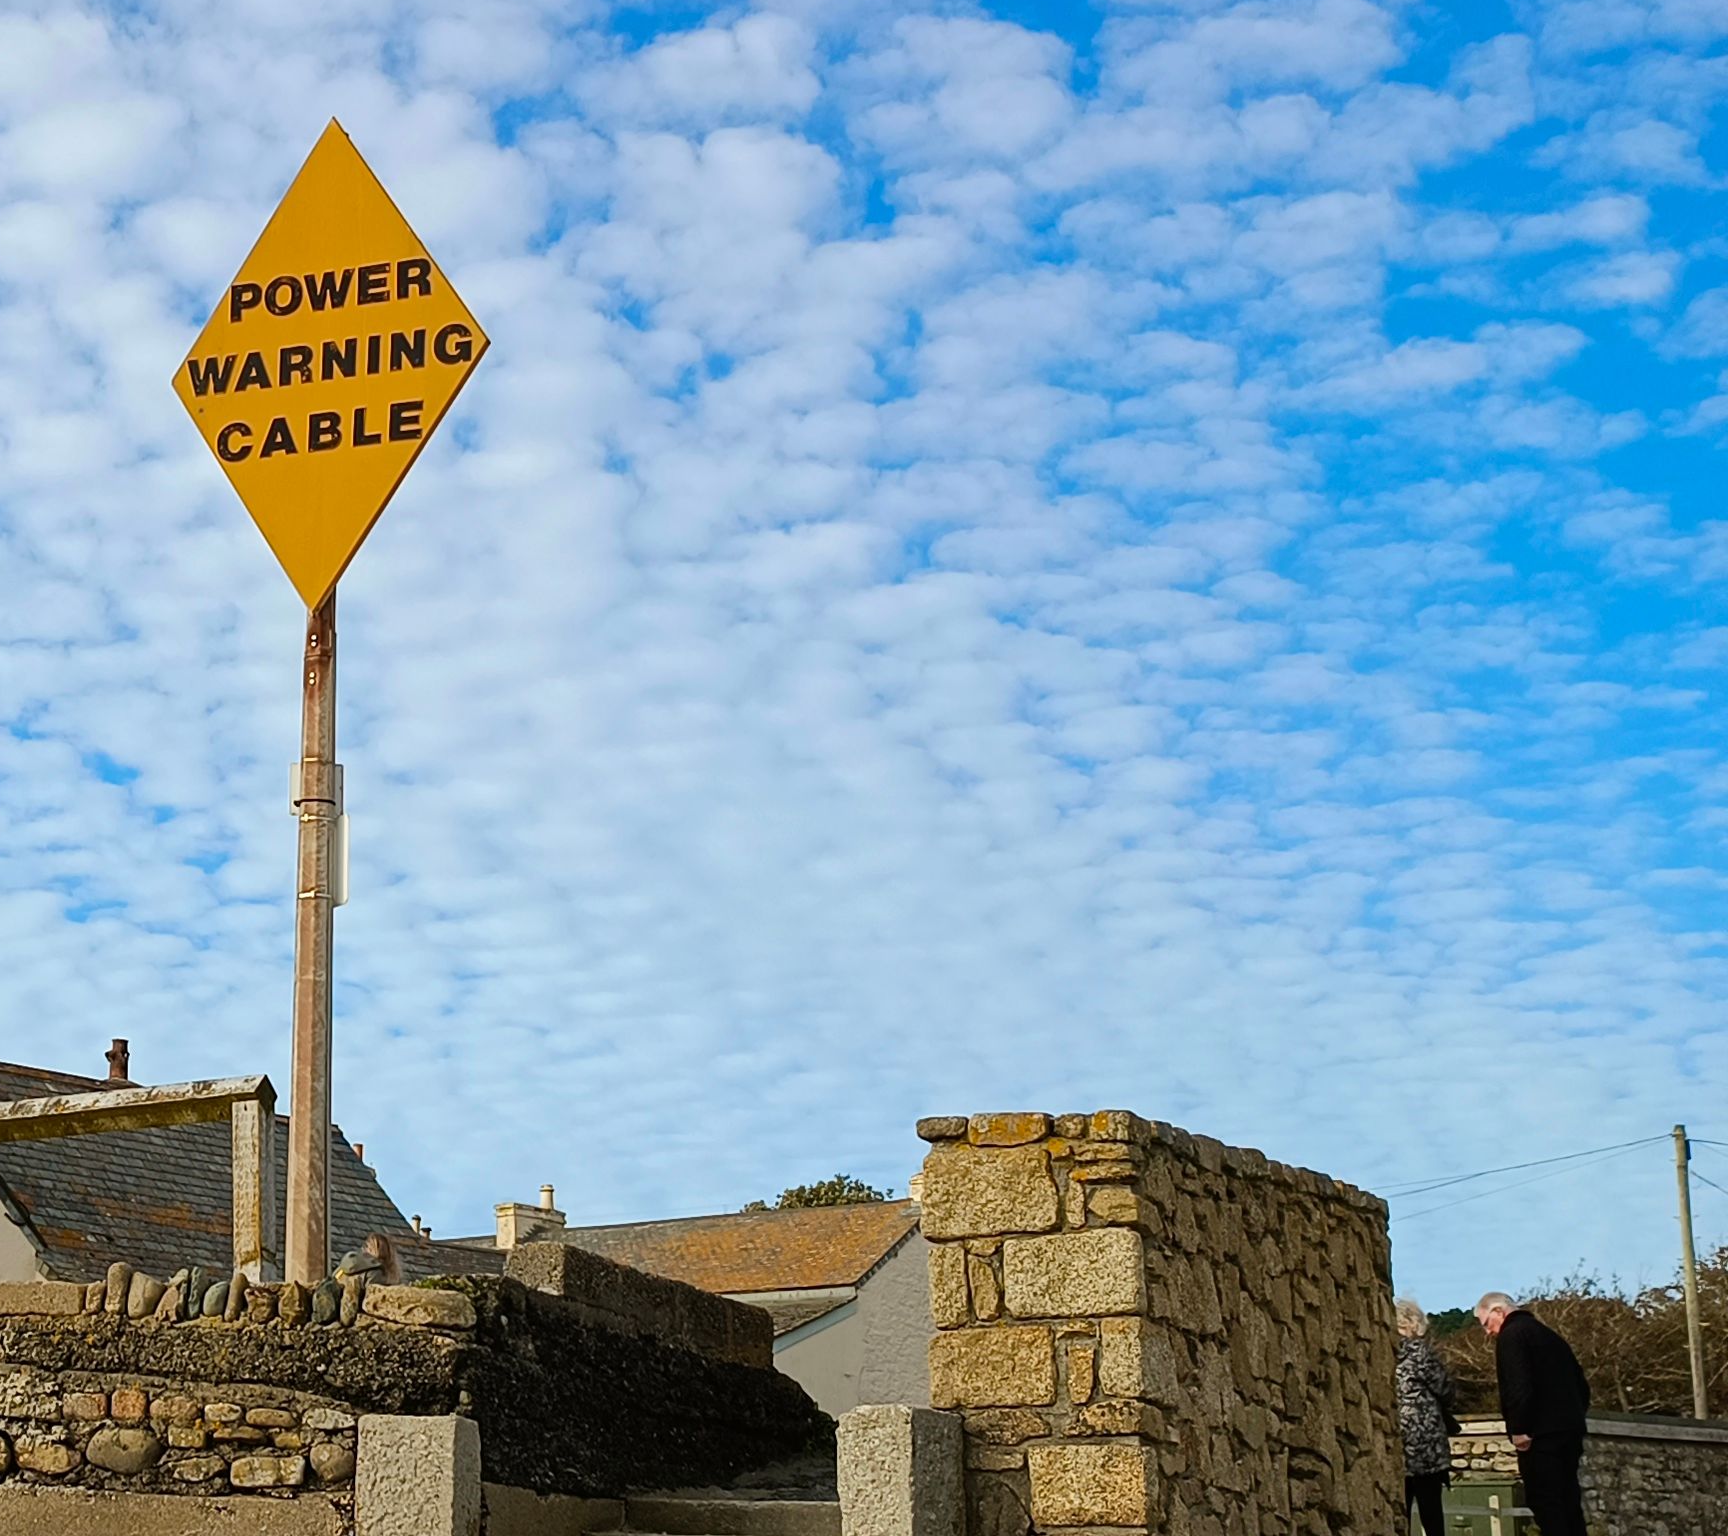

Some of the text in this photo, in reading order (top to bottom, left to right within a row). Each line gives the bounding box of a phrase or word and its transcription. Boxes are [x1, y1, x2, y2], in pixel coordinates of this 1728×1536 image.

[230, 258, 432, 323] POWER
[187, 323, 473, 397] WARNING
[217, 400, 424, 462] CABLE
